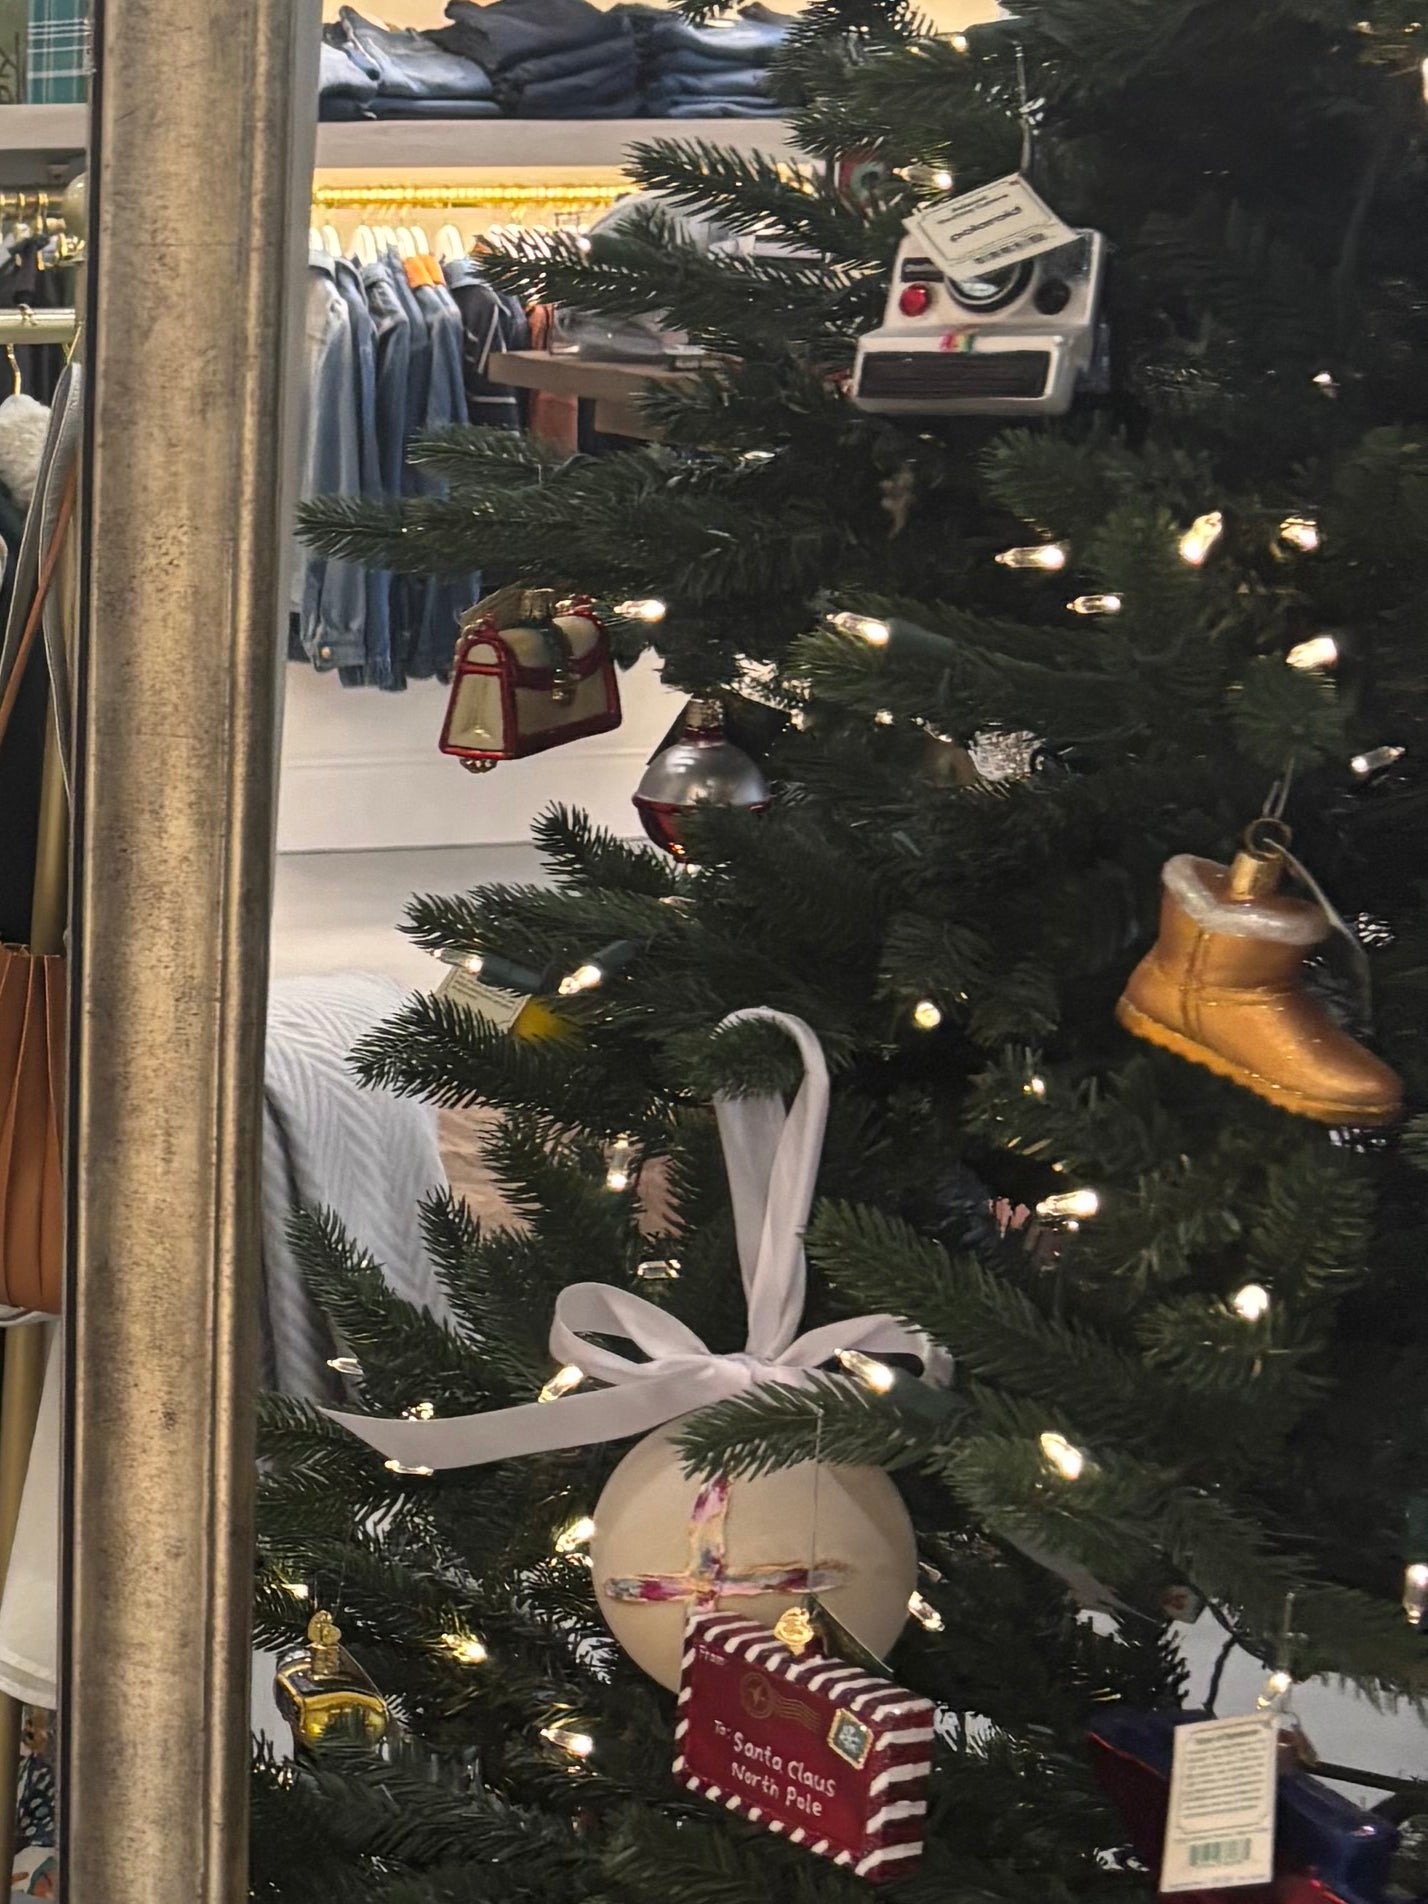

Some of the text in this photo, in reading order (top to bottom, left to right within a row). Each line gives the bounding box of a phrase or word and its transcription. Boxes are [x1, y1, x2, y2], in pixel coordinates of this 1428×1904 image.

[731, 1761, 823, 1817] North Pole
[733, 1731, 784, 1774] Santa
[787, 1760, 837, 1798] Claus
